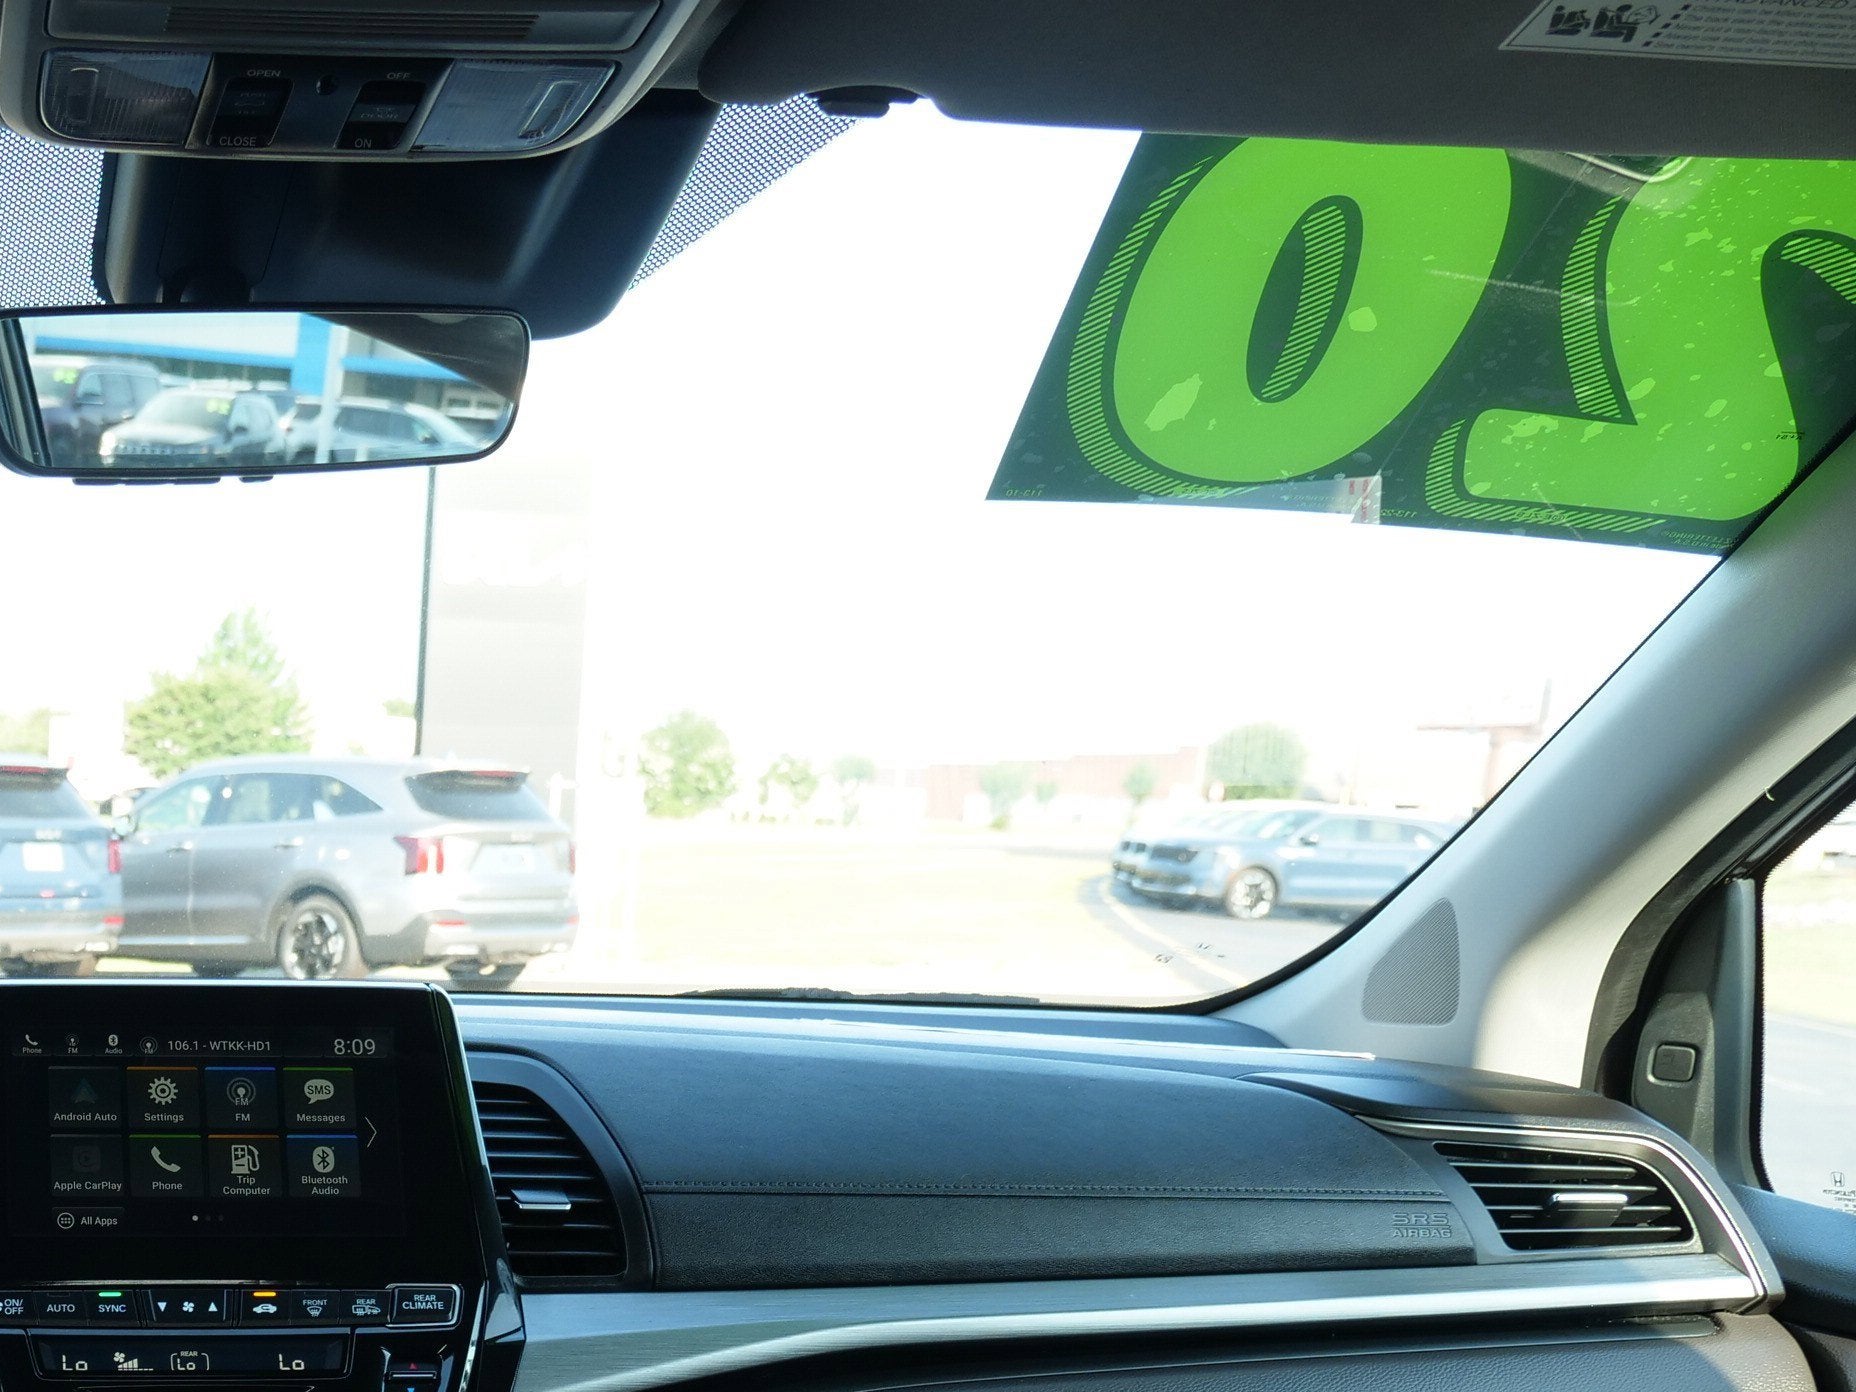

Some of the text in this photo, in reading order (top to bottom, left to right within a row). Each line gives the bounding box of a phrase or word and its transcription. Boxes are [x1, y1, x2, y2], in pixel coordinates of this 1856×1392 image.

[246, 70, 282, 78] OPEN
[386, 72, 412, 80] OFF
[219, 136, 256, 147] CLOSE
[354, 138, 372, 148] ON
[22, 1046, 42, 1054] Phone
[168, 1040, 198, 1050] 106.1
[210, 1040, 271, 1051] WTKK-HD1
[334, 1038, 376, 1055] 8:09
[306, 1084, 332, 1096] SMS
[54, 1112, 118, 1122] Android Auto
[144, 1112, 184, 1123] Settings
[235, 1114, 250, 1122] FM
[296, 1114, 346, 1124] Messages
[236, 1176, 256, 1184] Trip
[301, 1176, 348, 1184] Bluetooth
[54, 1181, 122, 1192] Apple CarPlay
[152, 1182, 182, 1190] Phone
[222, 1186, 270, 1196] Computer
[311, 1186, 339, 1195] Audio
[80, 1216, 118, 1226] All Apps
[1392, 1212, 1450, 1224] SRS
[1392, 1228, 1452, 1238] AIRBAG
[4, 1298, 24, 1308] ON/
[414, 1294, 436, 1302] REAR
[4, 1306, 24, 1315] OFF
[46, 1304, 76, 1313] AUTO
[98, 1304, 126, 1313] SYNC
[402, 1301, 444, 1310] CLIMATE
[62, 1354, 88, 1371] Lo
[278, 1354, 305, 1371] Lo
